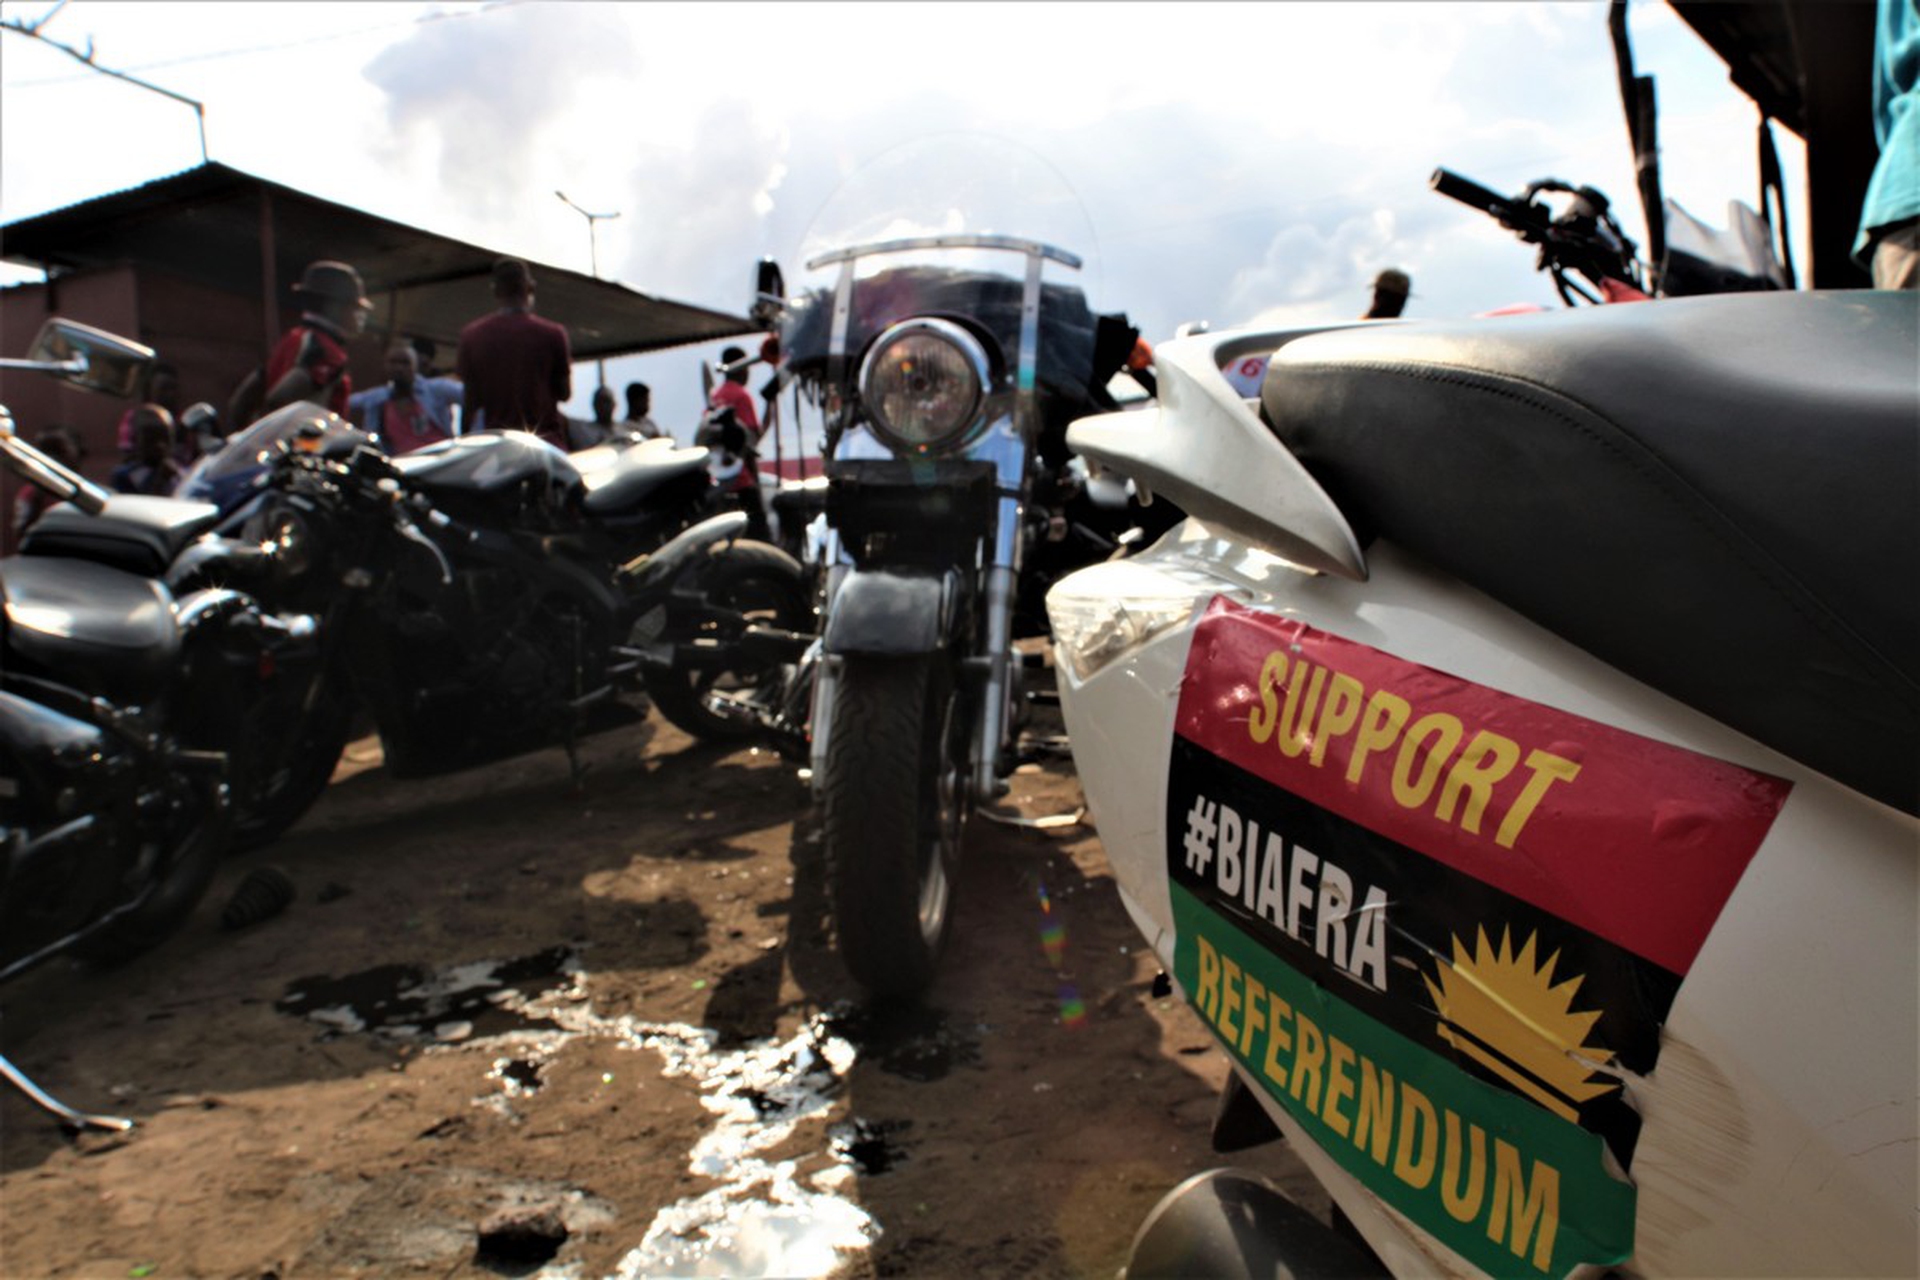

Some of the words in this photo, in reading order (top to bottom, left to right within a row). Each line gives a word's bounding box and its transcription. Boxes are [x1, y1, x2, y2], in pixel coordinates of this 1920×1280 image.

[1248, 651, 1581, 849] SUPPORT
[1184, 795, 1388, 992] #BIAFRA
[1197, 935, 1560, 1273] REFERENDUM
